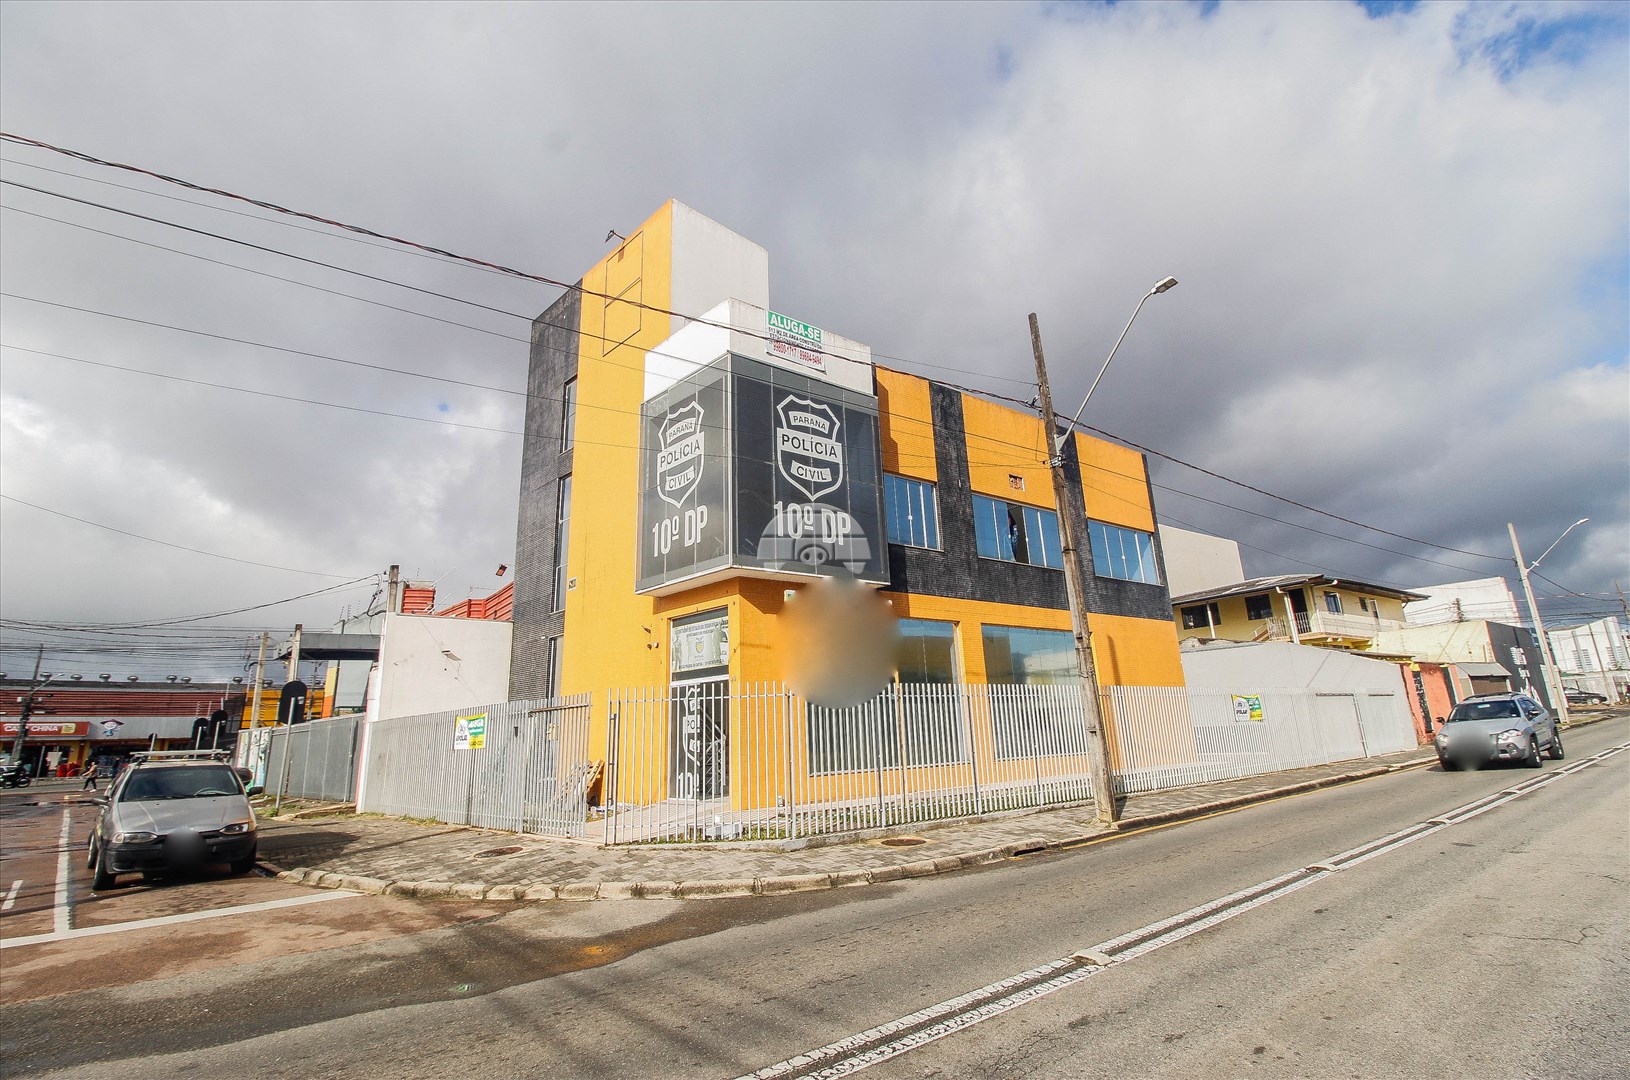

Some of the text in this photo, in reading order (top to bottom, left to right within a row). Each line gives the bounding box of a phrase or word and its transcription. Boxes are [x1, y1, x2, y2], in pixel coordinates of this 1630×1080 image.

[770, 313, 820, 342] ALUGA-SE
[660, 439, 700, 468] POLÍCIA
[782, 434, 837, 458] POLÍCIA
[668, 471, 691, 489] CIVIL
[797, 466, 827, 481] CIVIL
[685, 504, 708, 547] DP
[821, 508, 850, 545] DP
